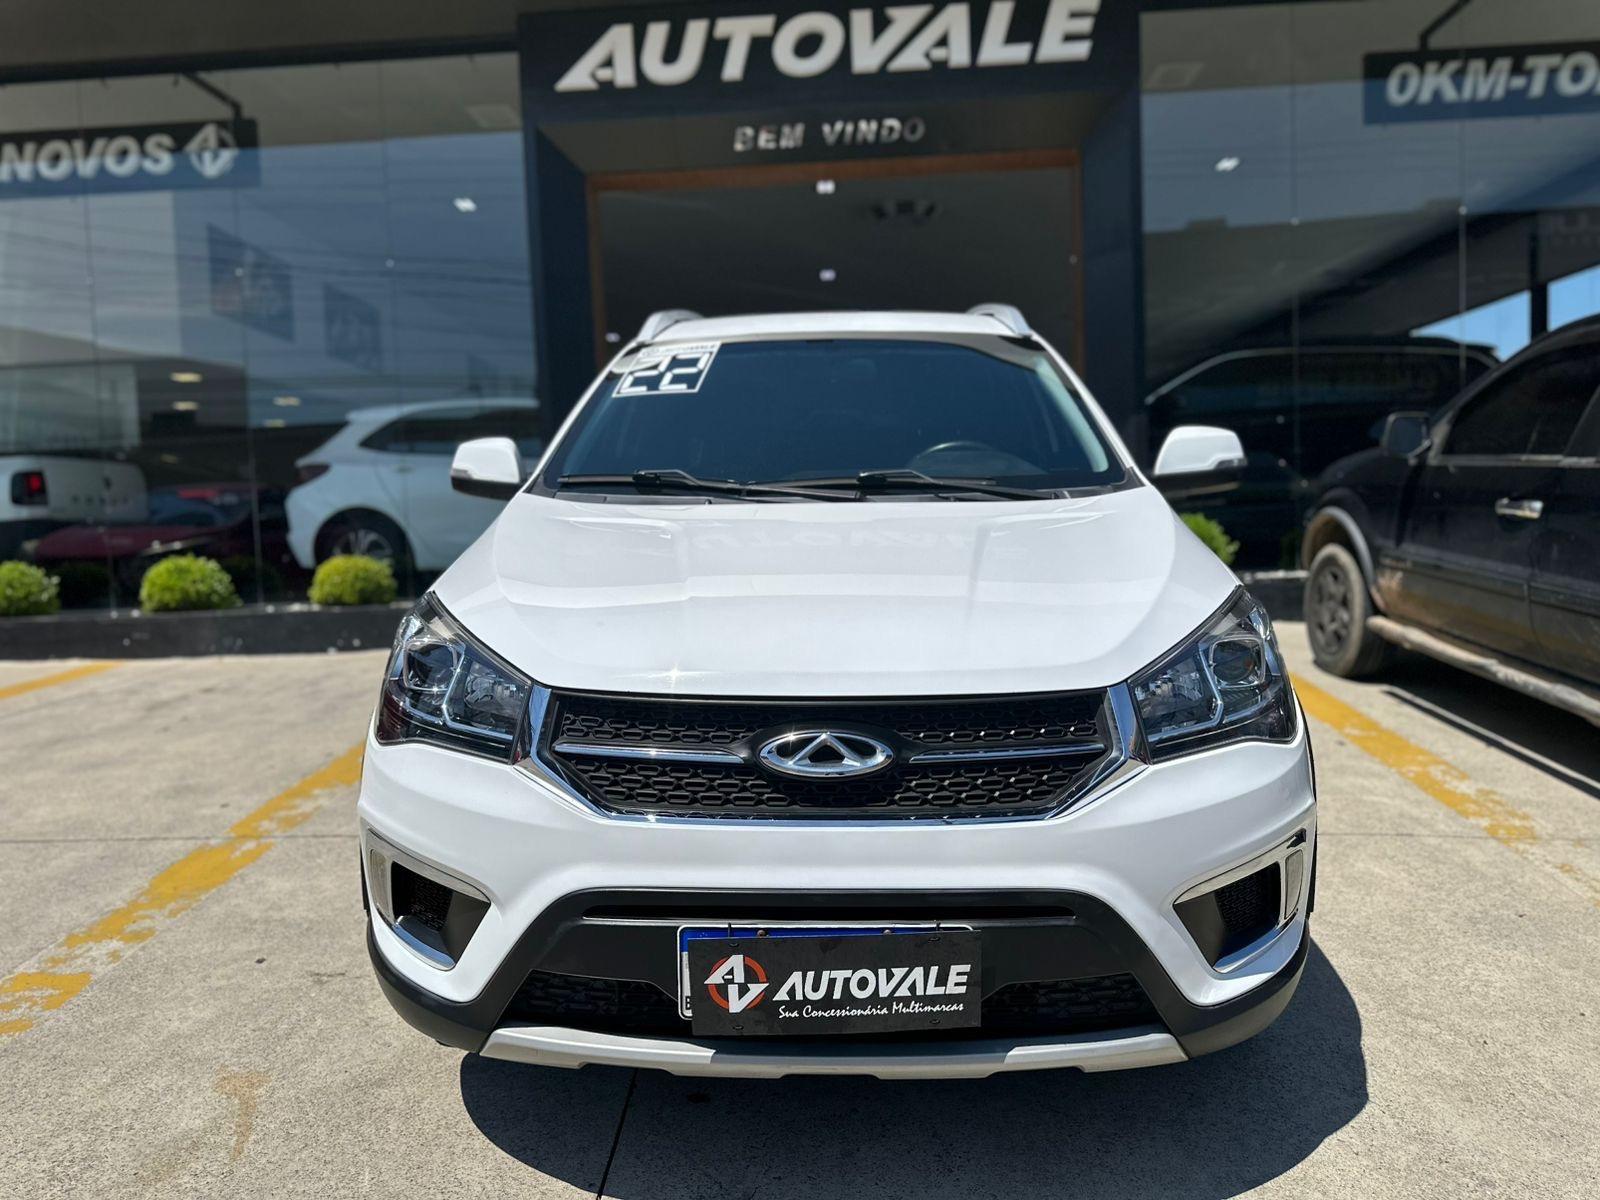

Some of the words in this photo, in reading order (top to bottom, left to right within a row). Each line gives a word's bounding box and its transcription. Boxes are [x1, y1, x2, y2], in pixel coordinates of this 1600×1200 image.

[555, 0, 1099, 92] AUTOVALE
[1386, 51, 1600, 106] 0KM-TO
[733, 122, 805, 153] BEM
[821, 116, 926, 147] VINDO
[619, 352, 711, 394] 22
[772, 963, 972, 1002] AUTOVALE
[778, 1005, 800, 1019] Sua
[802, 1002, 889, 1018] Concessionária
[892, 1000, 965, 1015] Multimarcas
